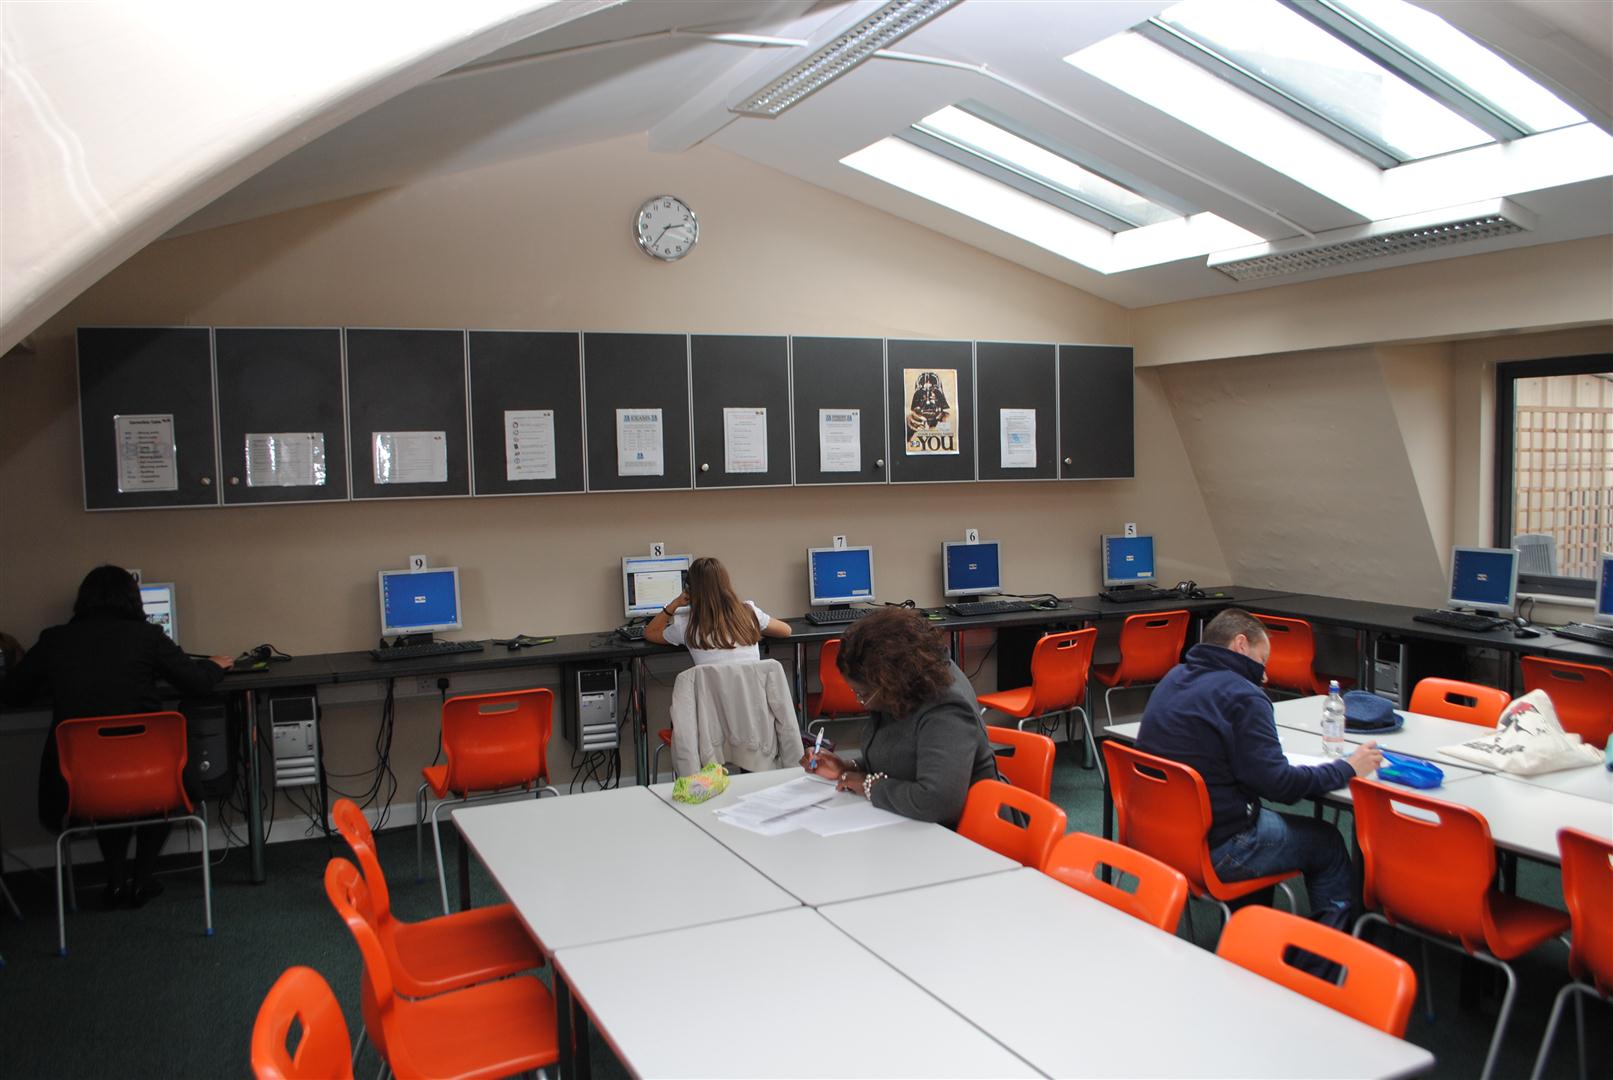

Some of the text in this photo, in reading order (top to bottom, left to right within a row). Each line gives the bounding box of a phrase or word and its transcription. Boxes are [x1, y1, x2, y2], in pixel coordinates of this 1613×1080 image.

[917, 435, 954, 451] YOU
[1128, 525, 1133, 535] 5
[969, 531, 976, 542] 6
[837, 537, 843, 548] 7
[654, 545, 662, 557] 8
[415, 558, 423, 569] 9
